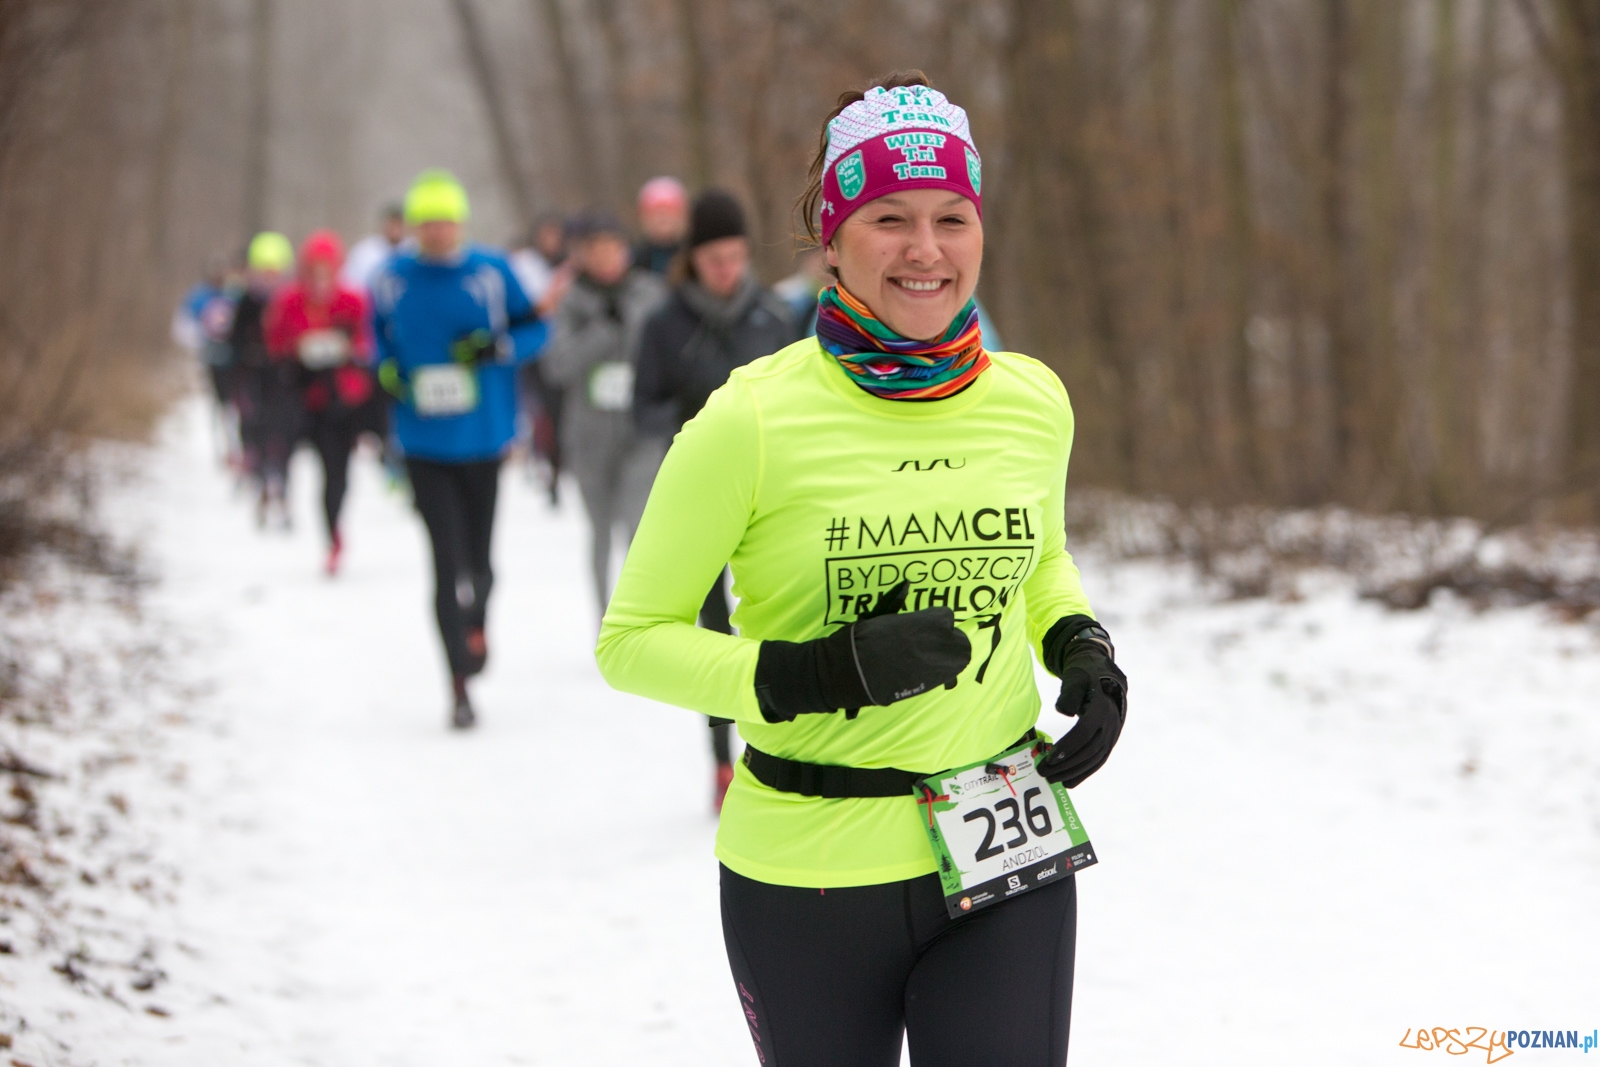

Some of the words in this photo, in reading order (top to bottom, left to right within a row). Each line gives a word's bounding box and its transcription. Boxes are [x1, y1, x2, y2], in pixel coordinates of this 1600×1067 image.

[881, 109, 951, 127] Team
[885, 133, 946, 149] WUEF
[902, 147, 935, 162] Tri
[894, 163, 946, 179] Team
[824, 507, 1036, 552] #MAMCEL
[837, 556, 1027, 591] BYDGOSZCZ
[838, 584, 1008, 616] TRITHLON
[962, 786, 1053, 863] 236
[1002, 845, 1049, 872] ANDZIOL
